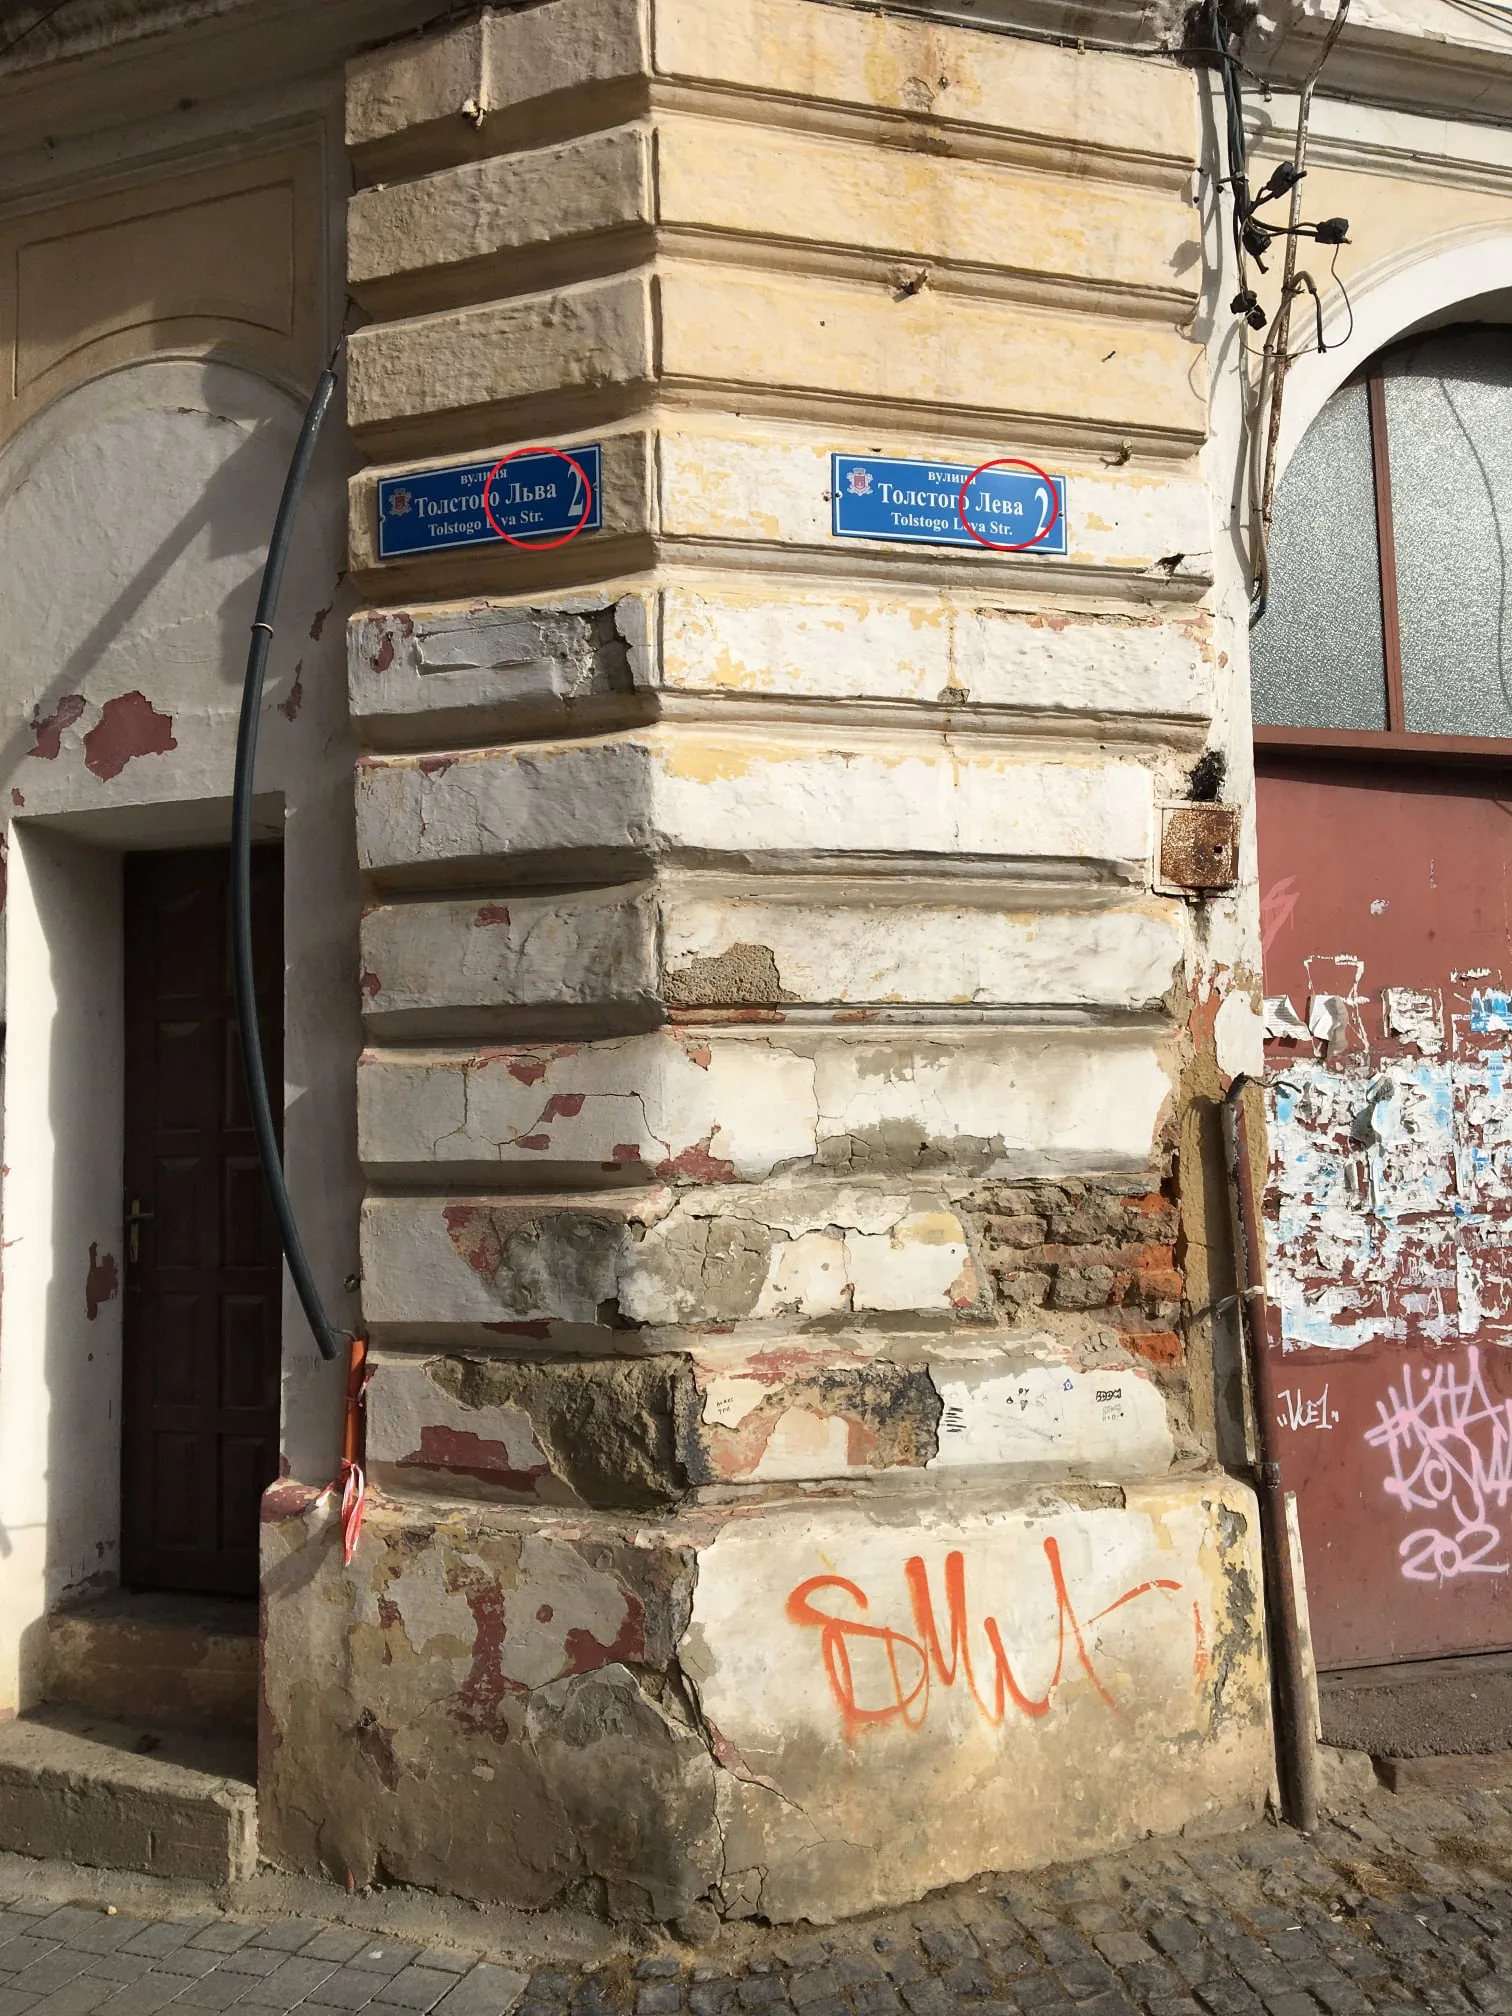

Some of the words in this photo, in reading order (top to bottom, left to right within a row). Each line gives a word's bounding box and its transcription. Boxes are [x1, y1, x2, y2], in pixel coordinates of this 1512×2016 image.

[414, 491, 500, 518] Толстого
[505, 482, 557, 505] Льва
[567, 462, 584, 517] 2
[878, 483, 970, 511] Толстого
[975, 491, 1024, 516] Лева
[1034, 487, 1050, 538] 2
[428, 520, 482, 537] Tolstogo
[520, 510, 544, 524] Str.
[890, 512, 949, 532] Tolstogo
[990, 520, 1013, 536] Str.
